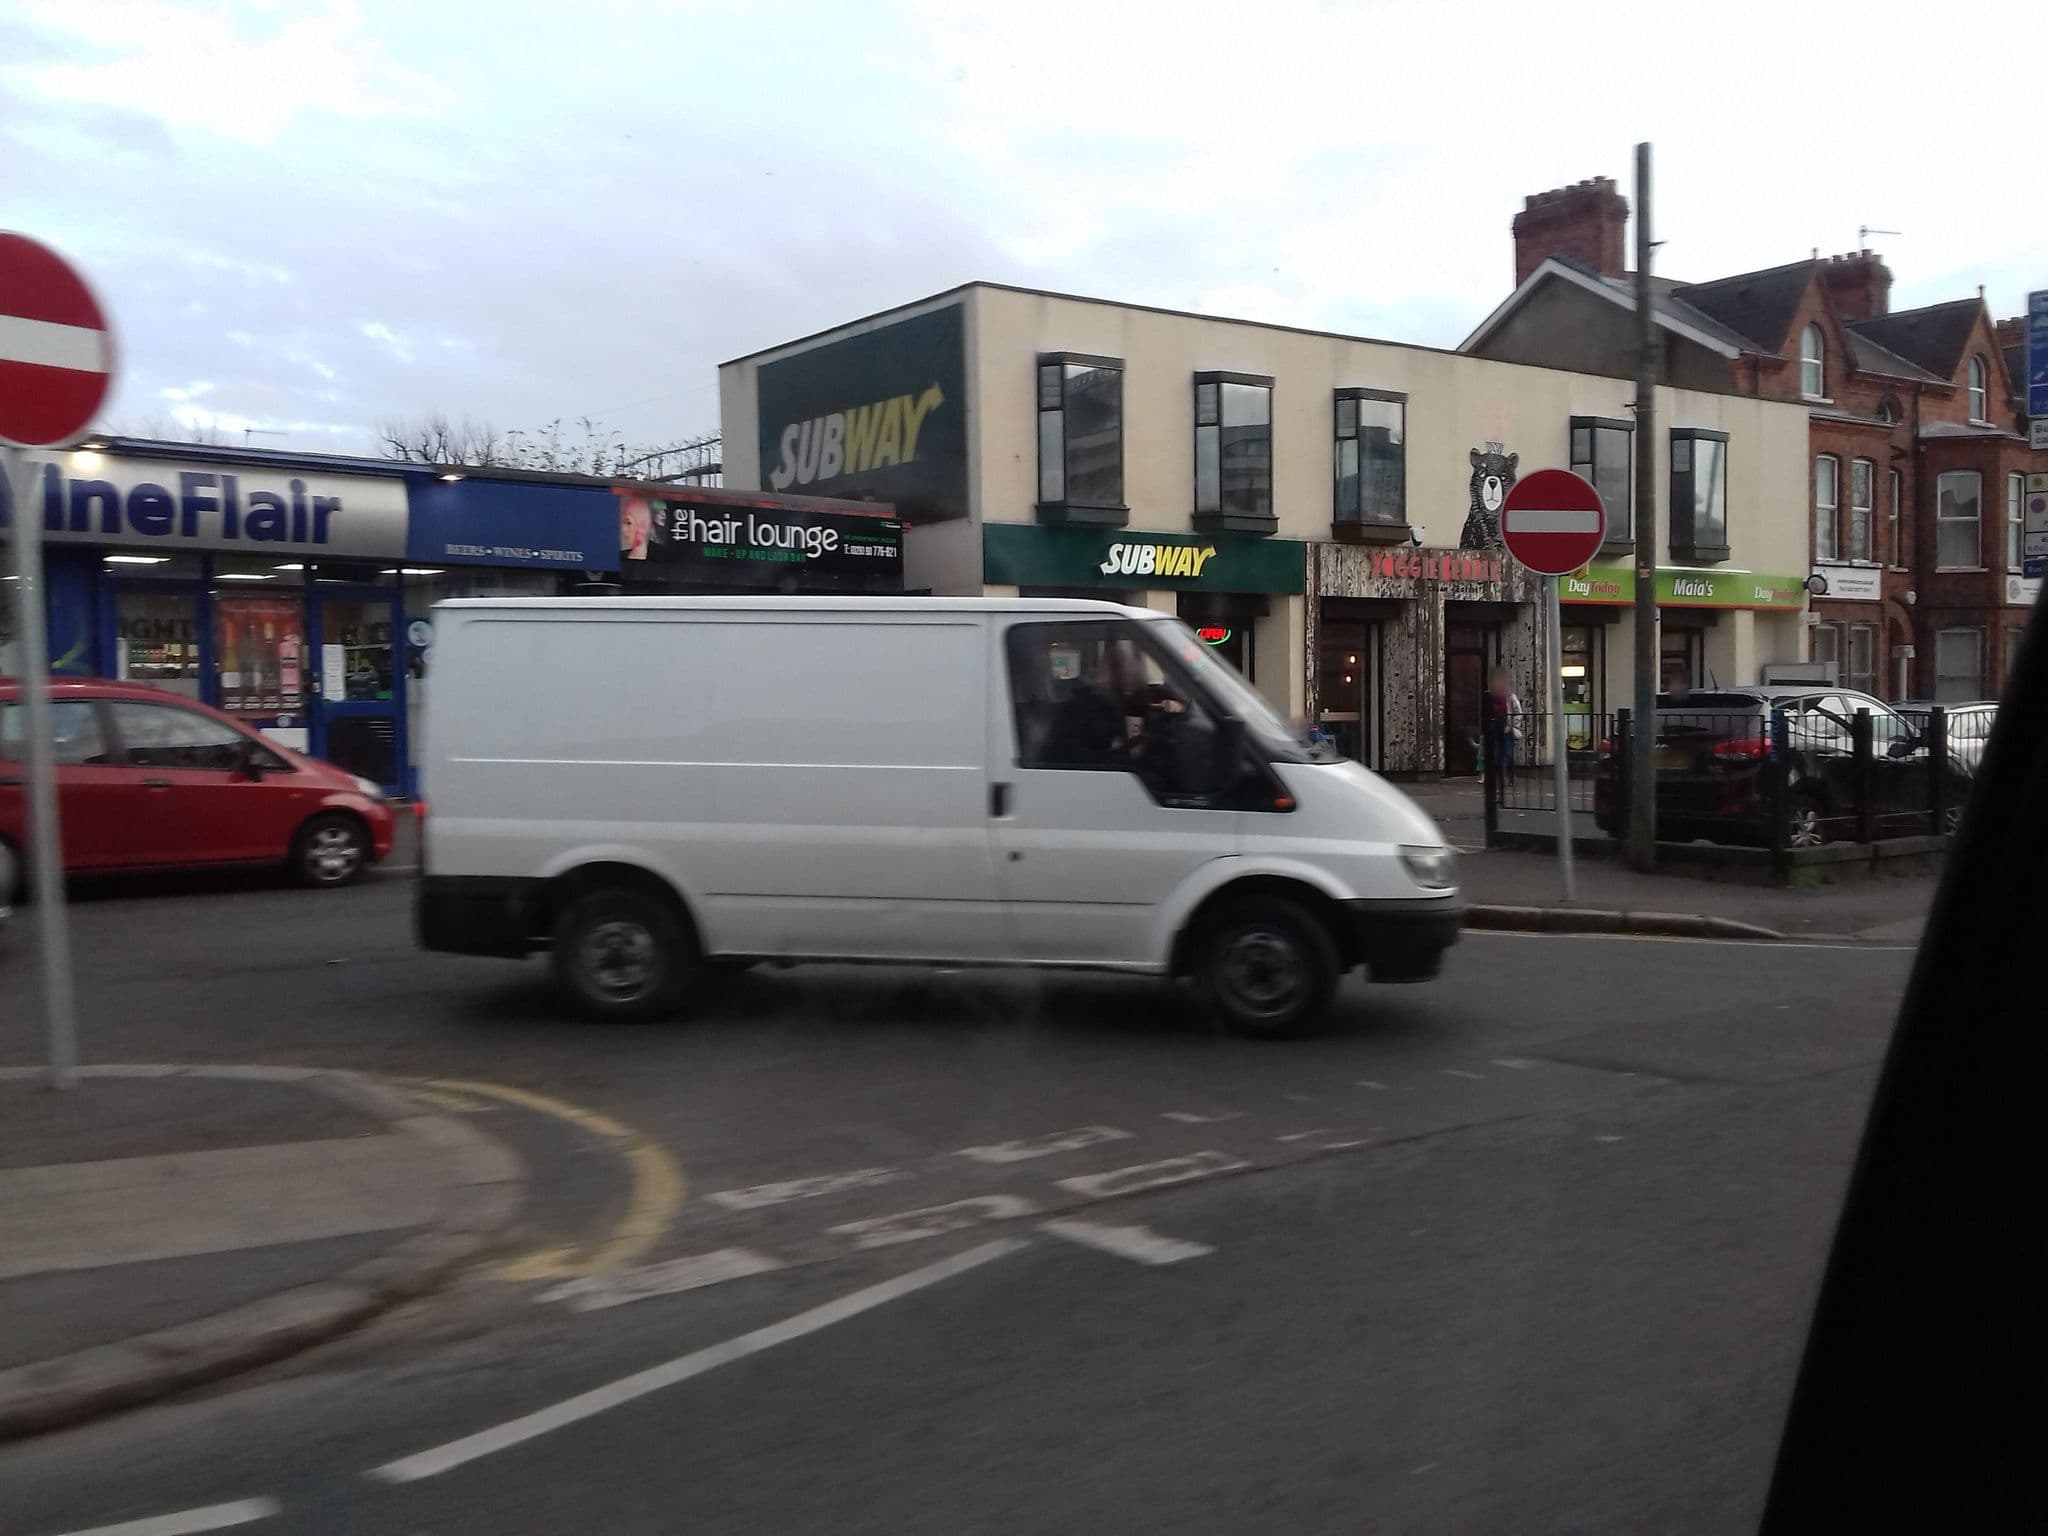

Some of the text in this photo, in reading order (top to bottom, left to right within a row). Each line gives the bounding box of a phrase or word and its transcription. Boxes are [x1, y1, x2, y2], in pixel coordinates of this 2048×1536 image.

[770, 380, 945, 491] SUBWAY
[0, 462, 342, 545] ineFlair
[670, 509, 688, 541] the
[689, 509, 839, 558] hair lounge
[493, 546, 532, 559] WINES
[540, 549, 584, 562] SPIRITS
[1100, 543, 1217, 577] SUBWAY
[1673, 578, 1714, 598] Maia's
[1199, 627, 1227, 640] OPEN
